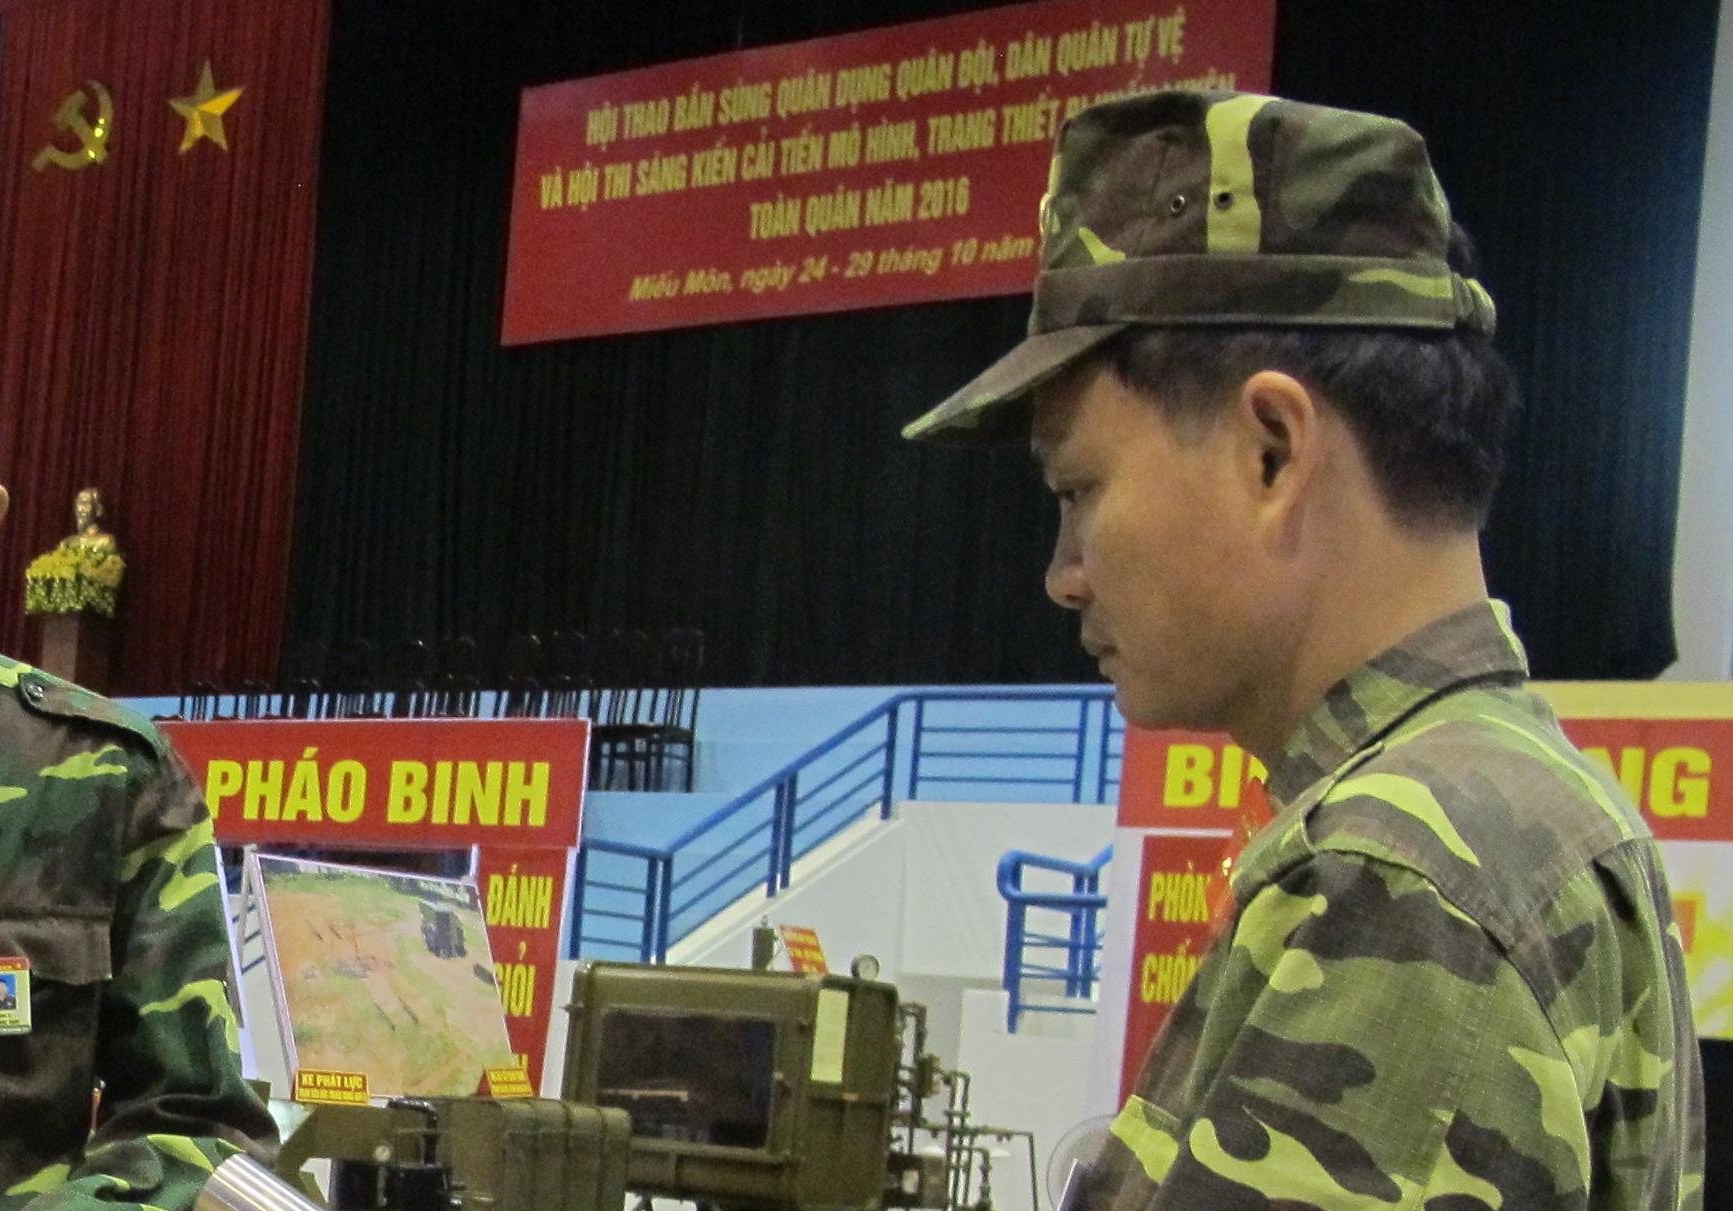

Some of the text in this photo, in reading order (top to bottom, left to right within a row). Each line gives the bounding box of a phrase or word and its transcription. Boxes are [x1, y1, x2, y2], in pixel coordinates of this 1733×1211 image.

[919, 175, 970, 220] 2016
[206, 746, 551, 827] PHÁO BINH
[1163, 744, 1269, 808] BI
[486, 863, 553, 929] ĐÁNH
